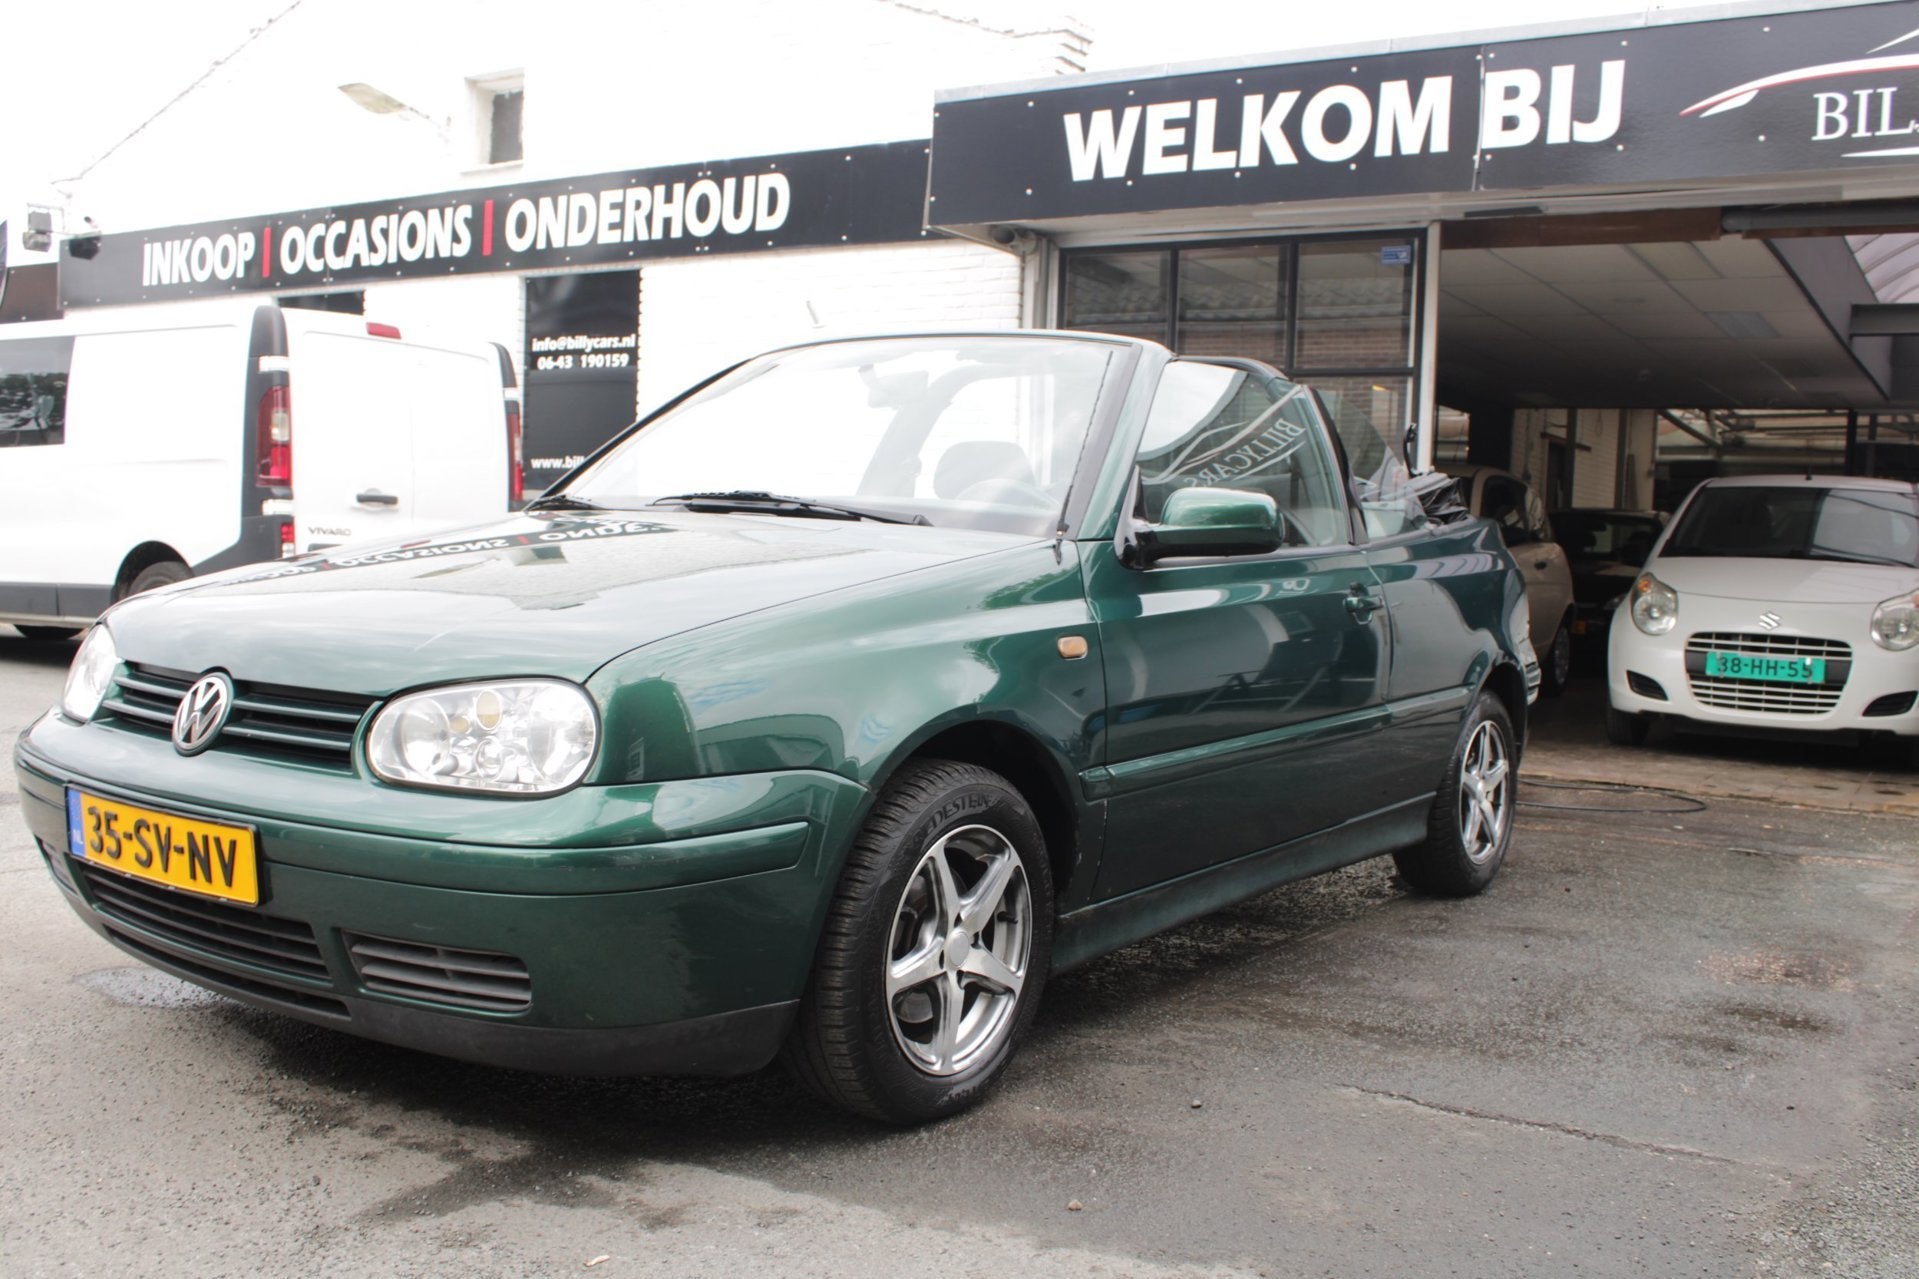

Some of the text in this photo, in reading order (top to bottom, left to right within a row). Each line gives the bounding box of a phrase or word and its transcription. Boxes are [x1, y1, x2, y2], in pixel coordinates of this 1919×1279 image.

[1062, 59, 1626, 183] WELKOM BIJ
[1811, 86, 1919, 141] BIL
[142, 172, 791, 287] INKOOP OCCASIONS ONDERHOUD
[531, 334, 636, 353] info@billycars.nl
[536, 353, 630, 370] 06-43 190159
[87, 806, 237, 888] 35-SV-NV
